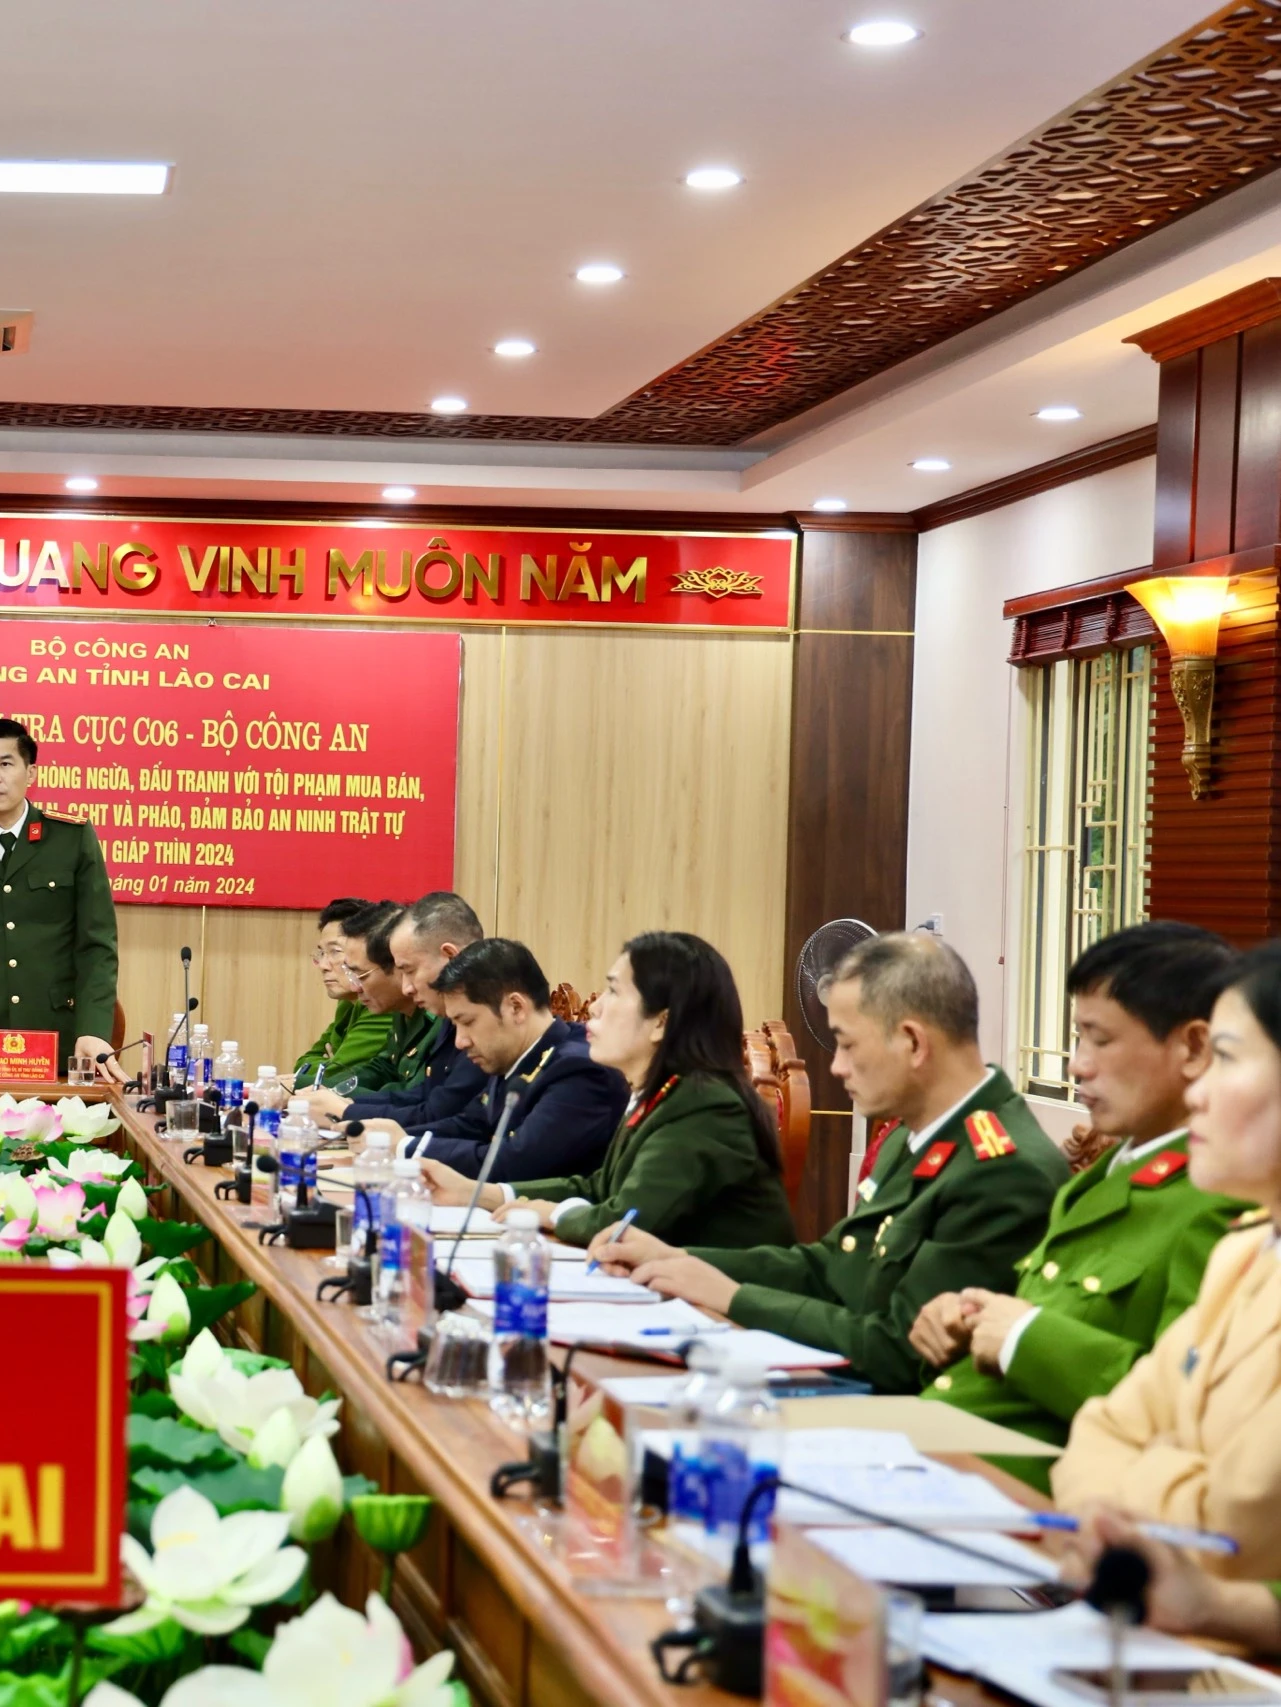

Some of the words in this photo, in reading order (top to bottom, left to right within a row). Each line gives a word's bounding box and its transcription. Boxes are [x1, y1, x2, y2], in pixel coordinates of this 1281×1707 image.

[176, 544, 306, 595] VINH
[328, 537, 499, 602] MUÔN
[521, 541, 648, 602] NĂM
[29, 634, 68, 661] BỘ
[73, 636, 148, 660] CÔNG
[153, 643, 190, 661] AN
[35, 666, 78, 685] AN
[84, 661, 150, 687] TỈNH
[158, 666, 215, 689] LÀO
[222, 672, 271, 691] CAI
[72, 714, 127, 753] CỤC
[132, 716, 179, 747] C06
[201, 709, 239, 756] BỘ
[245, 710, 323, 752] CÔNG
[328, 722, 370, 752] AN
[27, 759, 81, 789] HÒNG
[85, 762, 135, 793] NGỪA,
[138, 760, 173, 793] ĐẤU
[175, 769, 230, 794] TRANH
[233, 765, 260, 795] VỚI
[263, 767, 290, 800] TỘI
[293, 772, 341, 802] PHẠM
[345, 774, 382, 798] MUA
[386, 771, 425, 803] BÁN,
[112, 799, 134, 827] VÀ
[137, 800, 186, 832] PHÁO,
[189, 796, 228, 830] ĐẢM
[231, 797, 265, 831] BẢO
[267, 808, 292, 832] AN
[295, 809, 336, 833] NINH
[339, 806, 380, 839] TRẬT
[383, 810, 406, 840] TỰ
[111, 835, 150, 864] GIÁP
[153, 837, 192, 865] THÌN
[194, 842, 235, 867] 2024
[109, 873, 145, 897] áng
[148, 874, 169, 892] 01
[173, 876, 210, 894] năm
[215, 876, 255, 895] 2024
